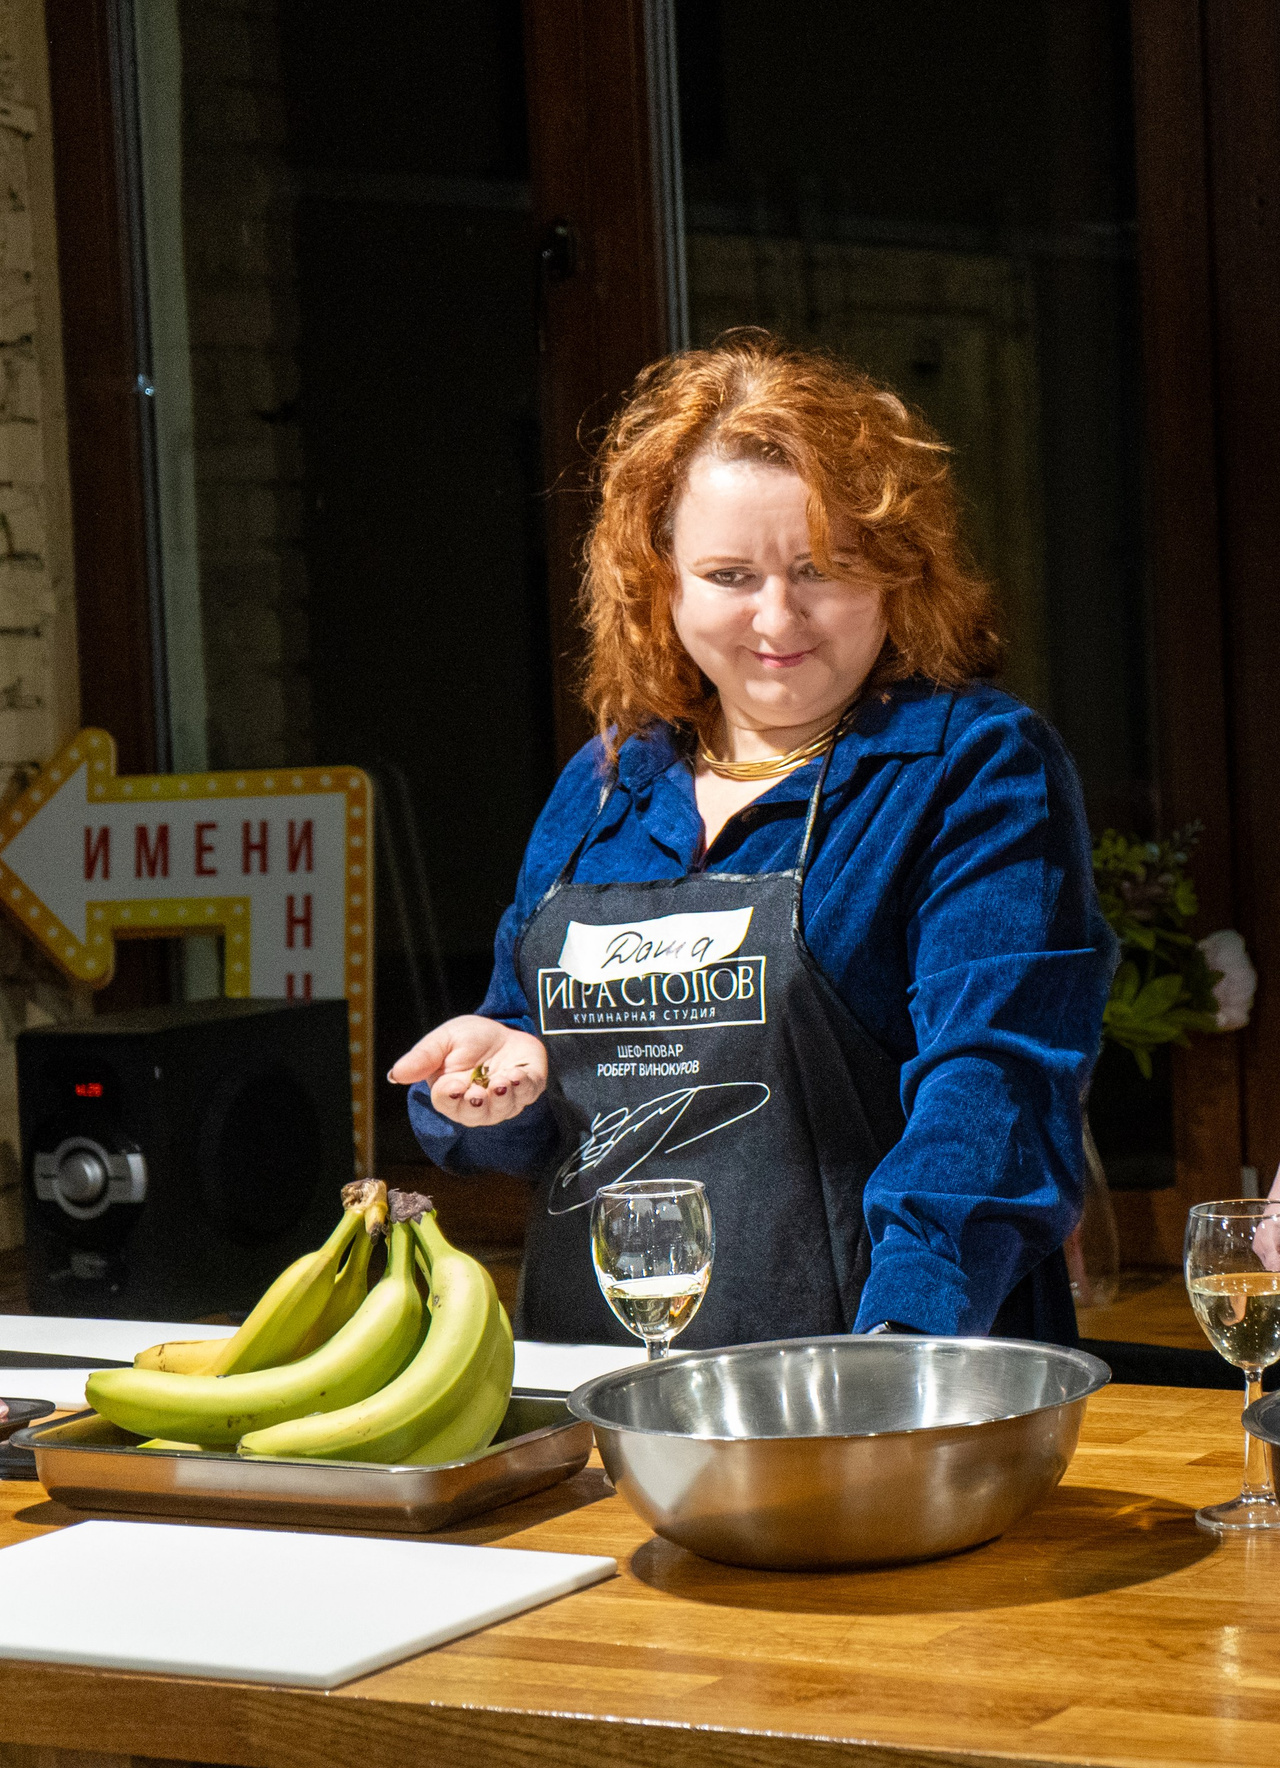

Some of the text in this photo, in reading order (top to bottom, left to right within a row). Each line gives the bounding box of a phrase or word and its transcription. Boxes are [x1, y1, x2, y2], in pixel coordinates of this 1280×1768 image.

[83, 818, 315, 882] ИМЕНИ
[620, 965, 755, 1007] СТОЛОВ
[573, 1006, 716, 1024] КУЛИНАРНАЯ СТУДИЯ
[617, 1043, 684, 1058] ШЕФ-ПОВАР
[597, 1060, 700, 1077] РОБЕРТ ВИНОКУРОВ
